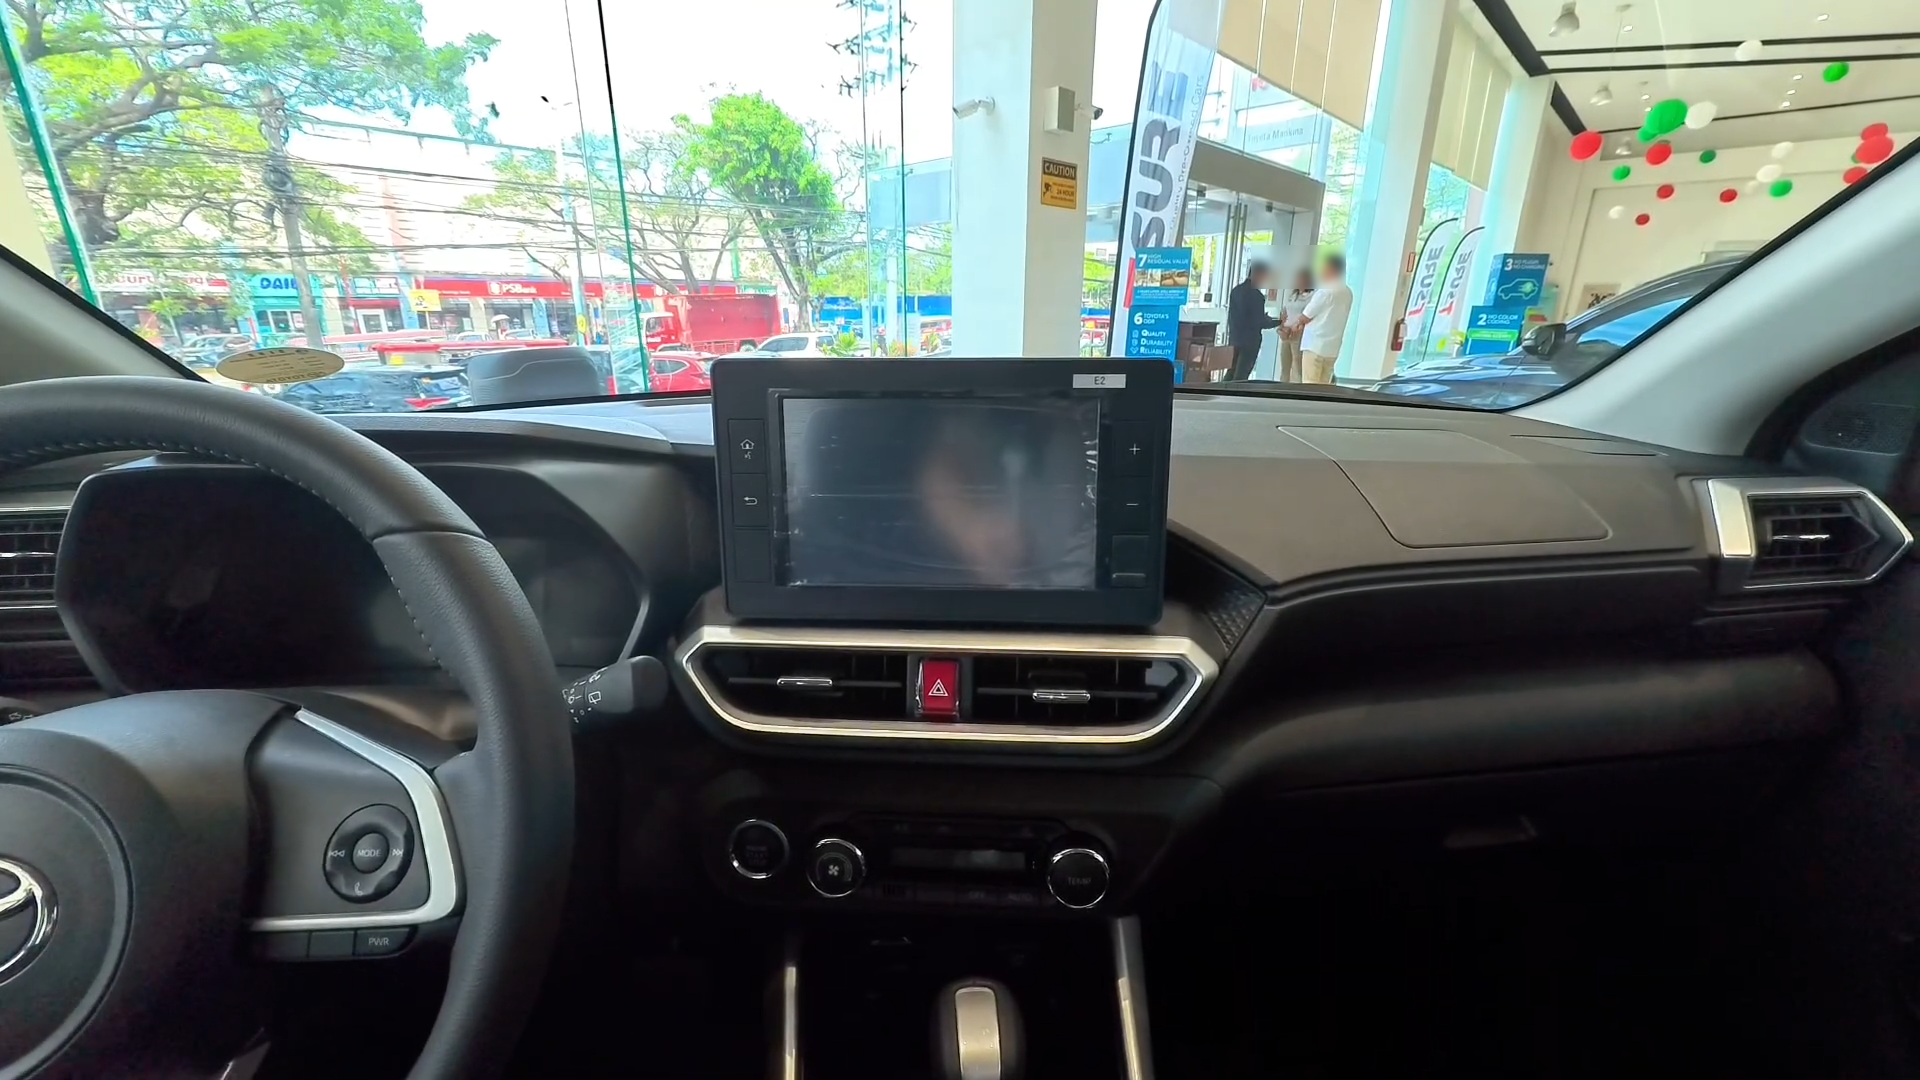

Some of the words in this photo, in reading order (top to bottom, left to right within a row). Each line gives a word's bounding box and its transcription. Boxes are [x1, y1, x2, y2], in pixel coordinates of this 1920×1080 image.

[1190, 75, 1205, 105] Cars
[1044, 162, 1075, 178] CAUTION
[1138, 253, 1148, 268] 7
[1504, 258, 1514, 271] 3
[503, 283, 538, 294] PSBank
[1133, 312, 1143, 325] 6
[1477, 313, 1488, 326] 2
[1140, 338, 1173, 346] DURABILITY
[1140, 347, 1172, 355] RELIABILITY
[1094, 375, 1106, 386] E2
[356, 848, 382, 857] MODE
[1066, 876, 1092, 886] TEMP
[368, 937, 390, 946] PWR
